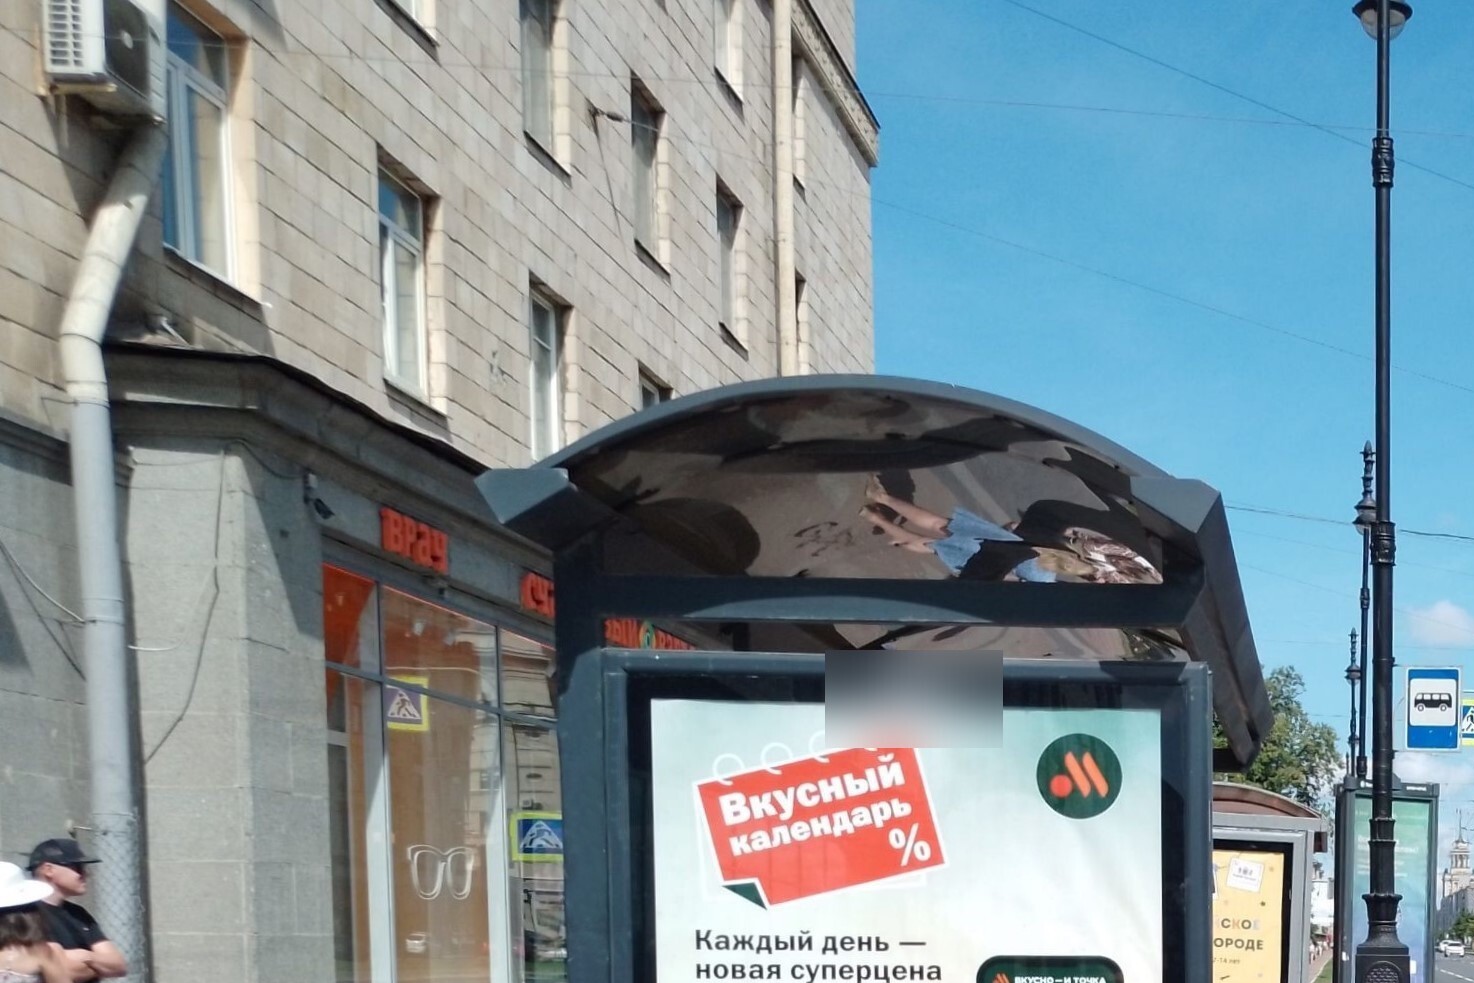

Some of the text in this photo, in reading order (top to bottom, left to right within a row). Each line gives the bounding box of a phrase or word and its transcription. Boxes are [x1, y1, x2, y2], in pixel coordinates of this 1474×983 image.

[719, 753, 905, 826] Вкусный
[729, 798, 912, 856] календарь
[888, 823, 931, 866] %
[695, 930, 813, 954] Каждый
[822, 934, 889, 954] день
[696, 963, 781, 979] новая
